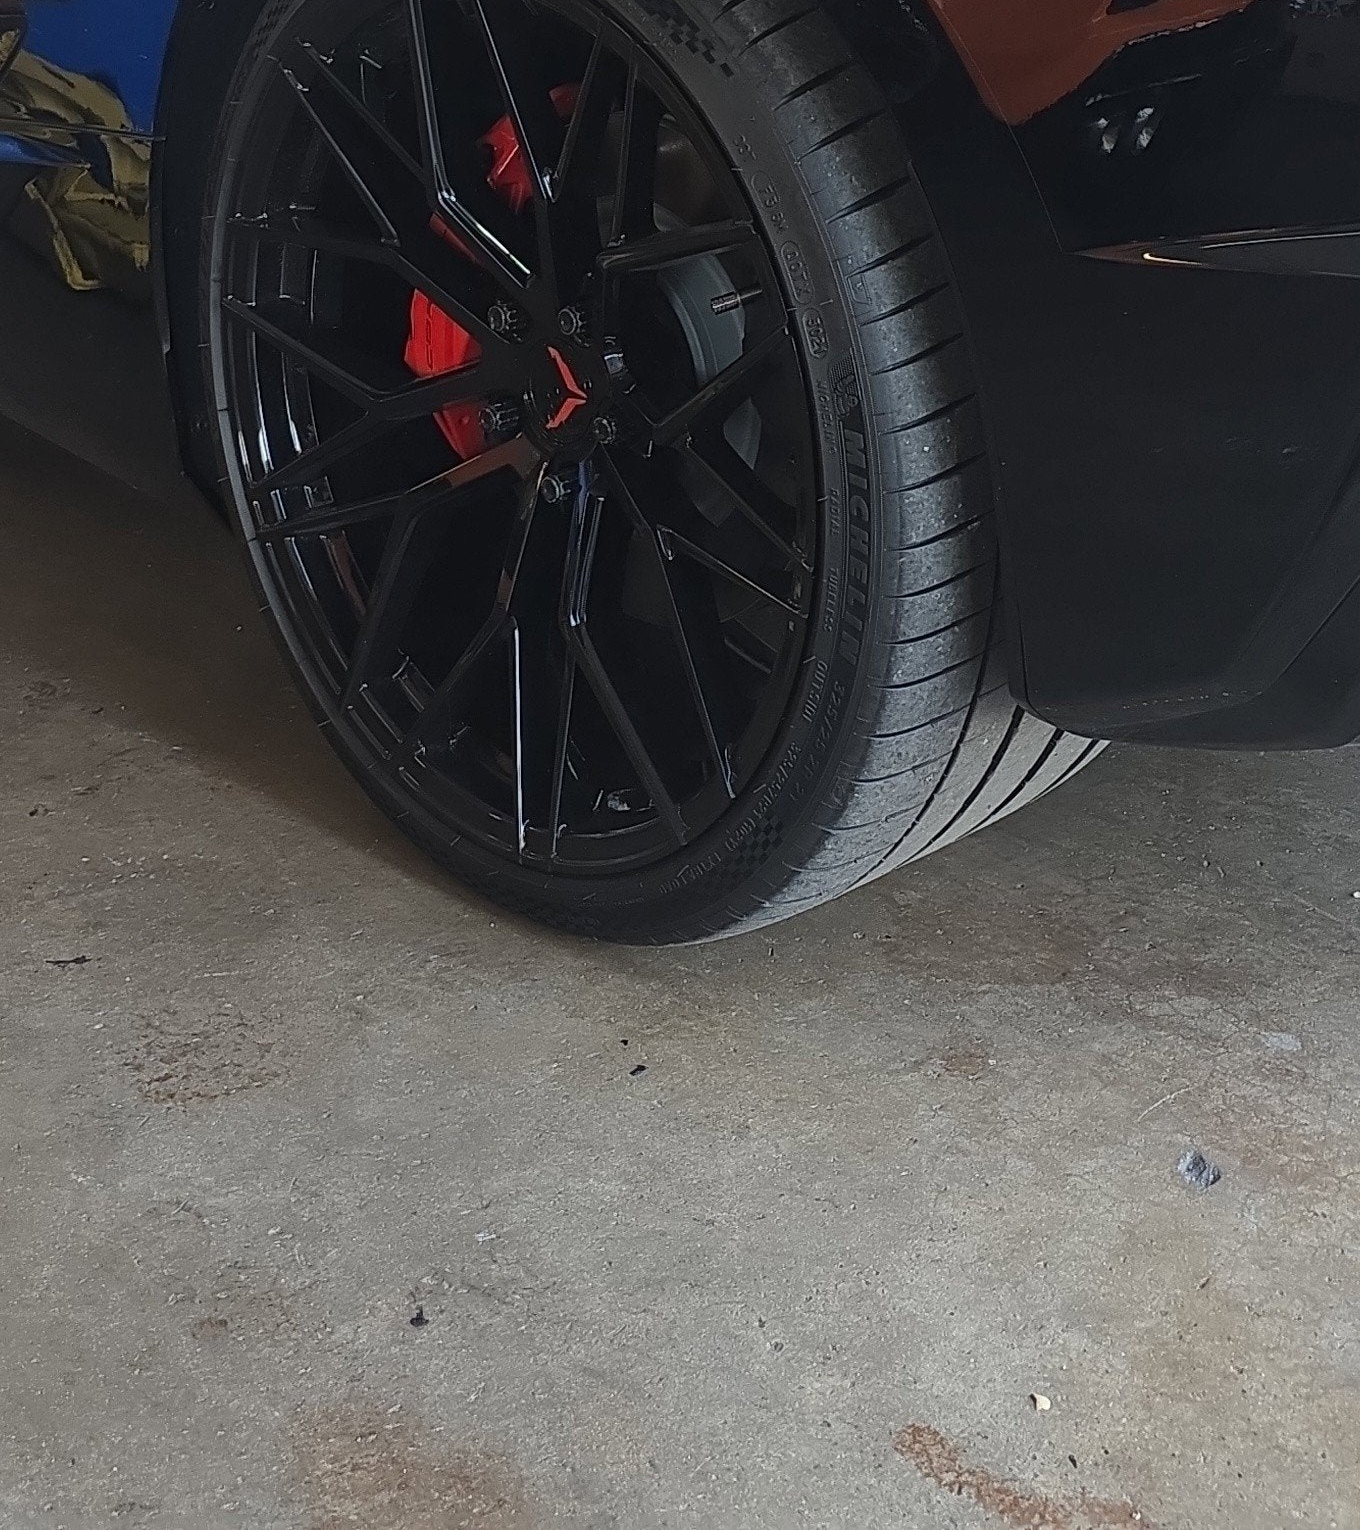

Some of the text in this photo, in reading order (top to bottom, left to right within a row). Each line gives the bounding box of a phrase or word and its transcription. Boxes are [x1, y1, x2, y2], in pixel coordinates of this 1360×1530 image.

[829, 487, 840, 536] RADIAL
[838, 430, 869, 664] MICHELIN
[823, 566, 840, 633] TUBELESS
[815, 680, 846, 750] 325/25
